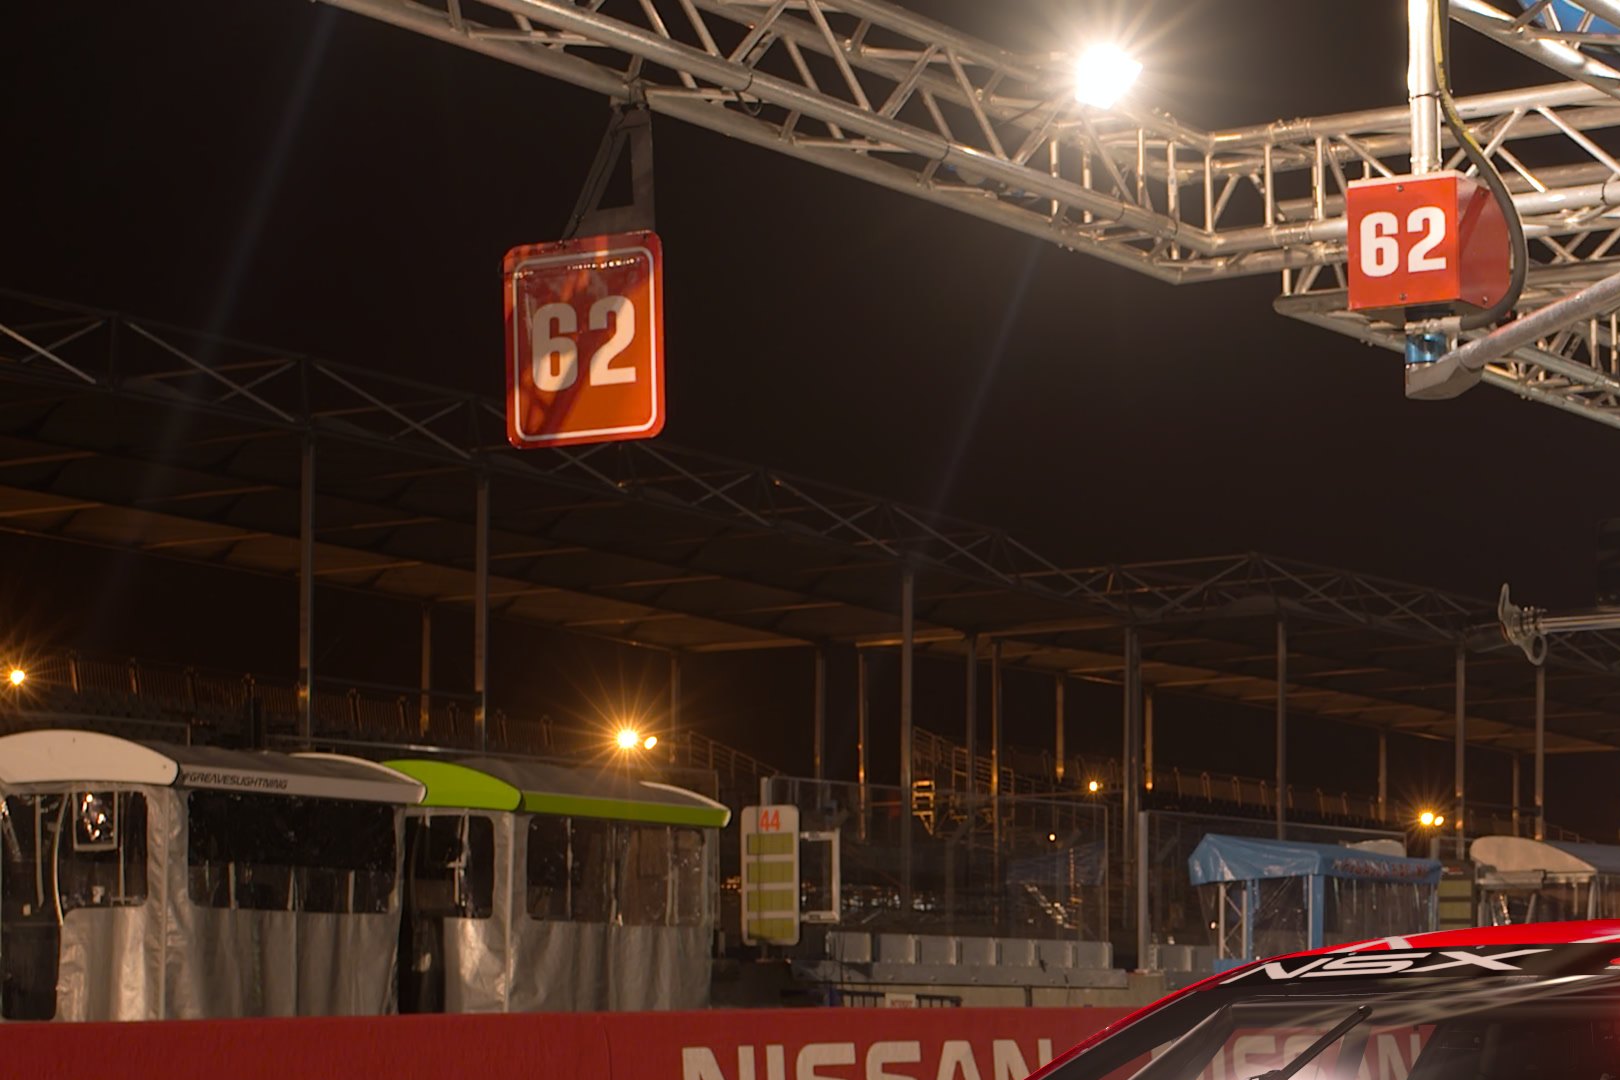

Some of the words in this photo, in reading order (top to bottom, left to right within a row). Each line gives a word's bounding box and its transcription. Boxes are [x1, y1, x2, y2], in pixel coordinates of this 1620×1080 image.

[1360, 206, 1447, 277] 62
[532, 295, 637, 392] 62
[759, 809, 781, 832] 44
[1220, 948, 1552, 985] NSX
